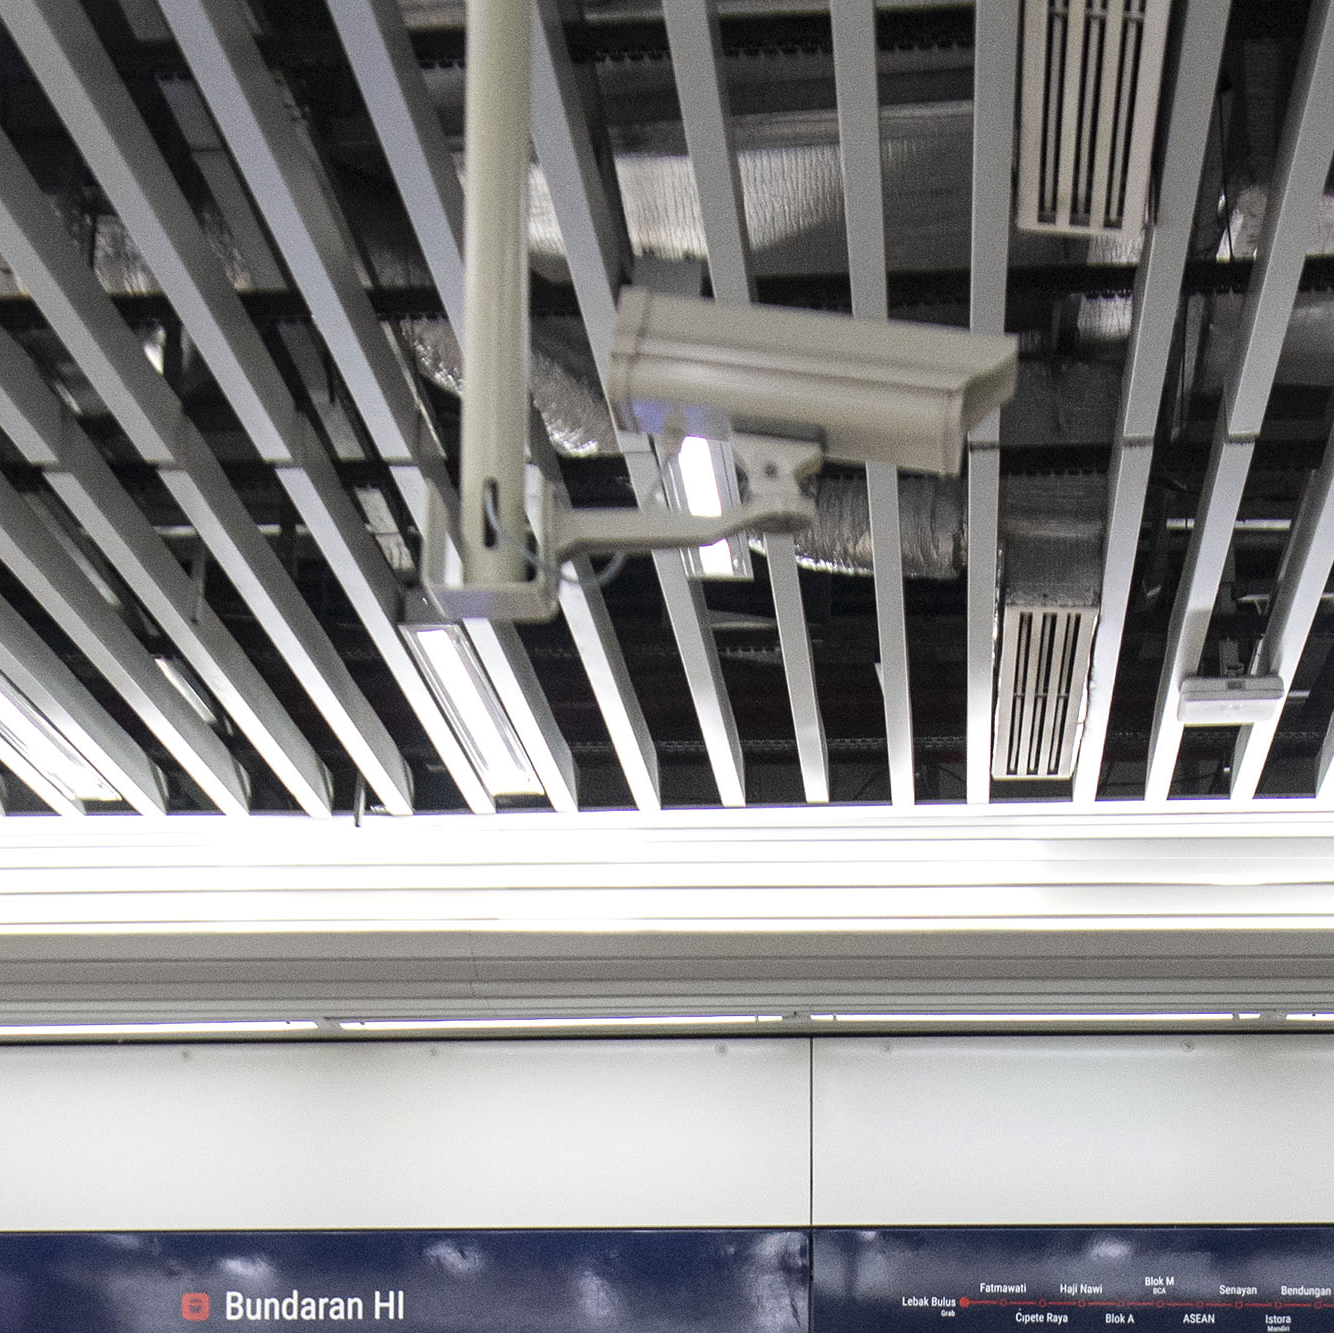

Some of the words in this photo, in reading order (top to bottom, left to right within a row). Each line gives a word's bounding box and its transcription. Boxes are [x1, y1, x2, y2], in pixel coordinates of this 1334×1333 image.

[979, 1282, 1027, 1293] Fatmawati
[1144, 1276, 1164, 1287] Blok
[1165, 1276, 1175, 1286] M
[1059, 1283, 1079, 1296] Haji
[1080, 1283, 1103, 1294] Nawi
[1219, 1284, 1258, 1297] Senayan
[1280, 1285, 1332, 1298] Bendungan
[225, 1289, 364, 1320] Bundaran
[374, 1290, 405, 1320] HI
[901, 1296, 929, 1307] Lebak
[930, 1296, 957, 1307] Bulus
[1015, 1312, 1044, 1324] Cipete
[1045, 1313, 1069, 1325] Raya
[1105, 1313, 1123, 1324] Blok
[1124, 1313, 1135, 1324] A
[1182, 1313, 1215, 1324] ASEAN
[1265, 1313, 1292, 1325] Istora
